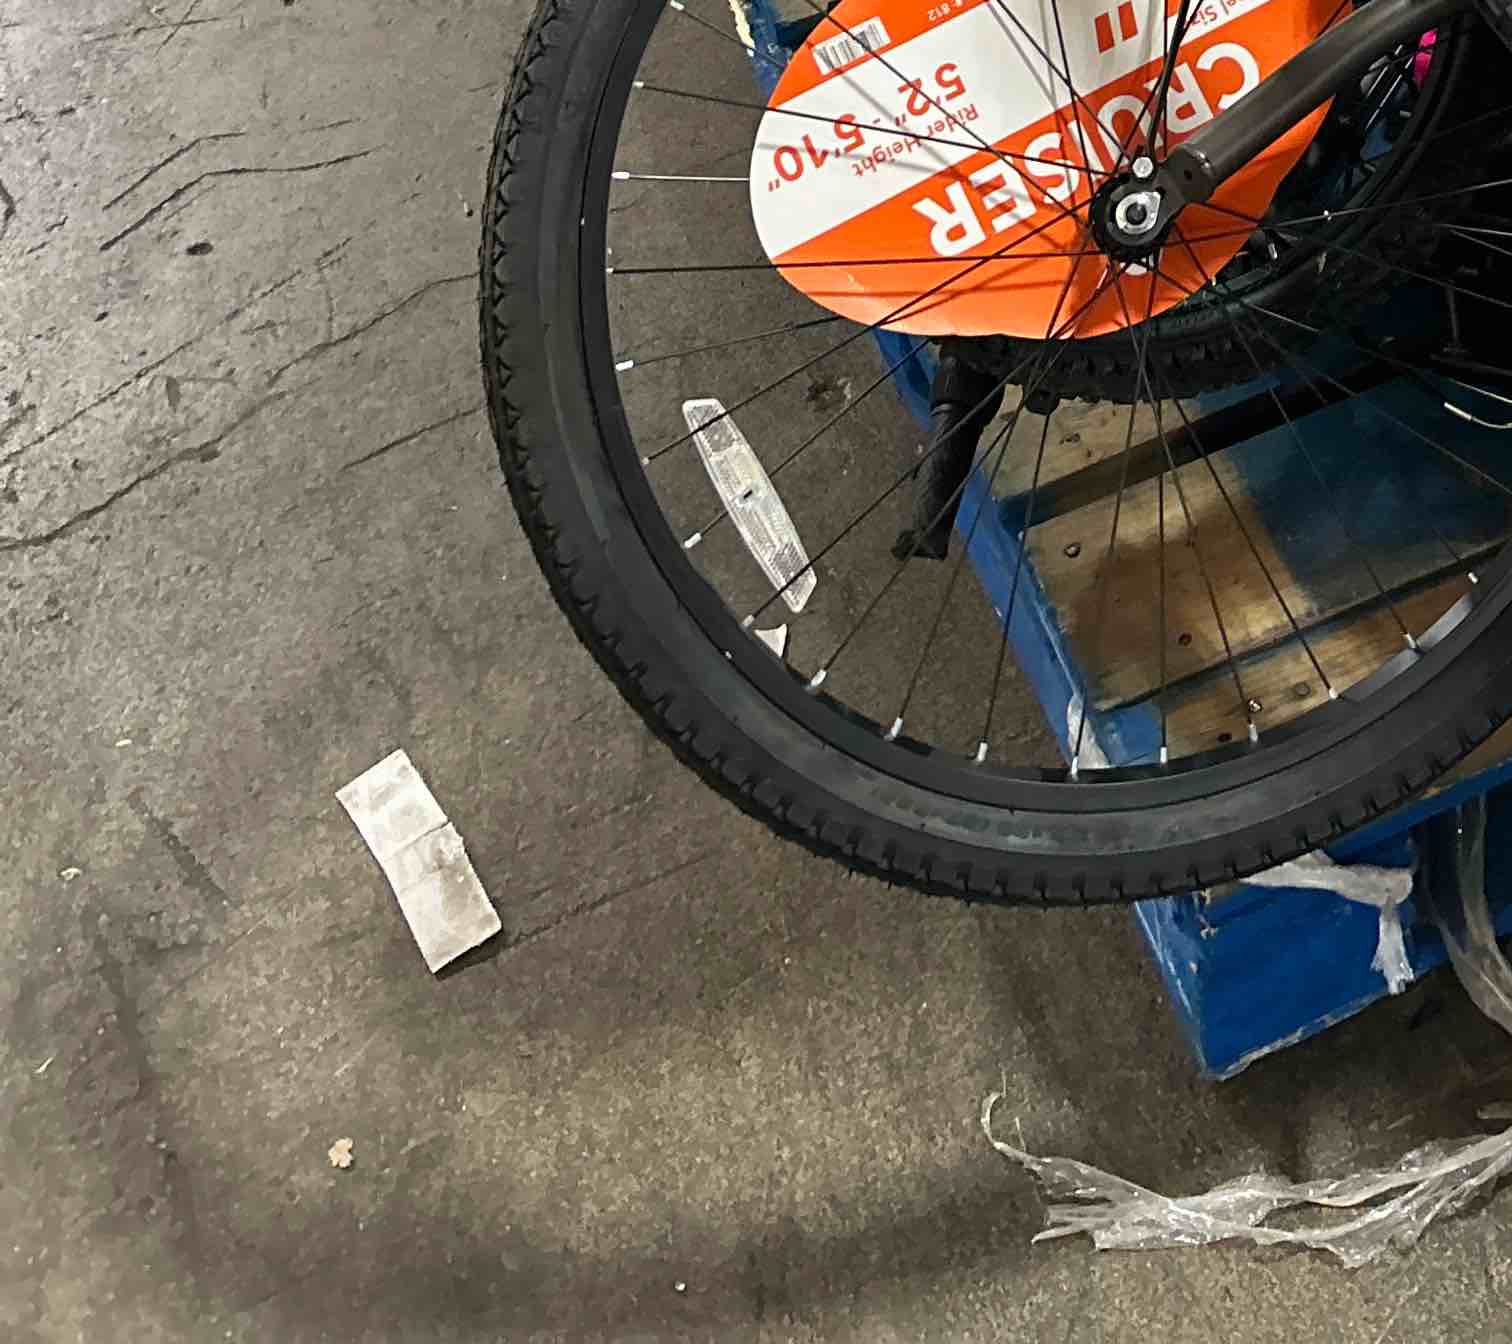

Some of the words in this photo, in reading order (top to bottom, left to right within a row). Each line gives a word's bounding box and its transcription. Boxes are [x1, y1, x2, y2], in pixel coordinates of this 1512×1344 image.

[928, 2, 950, 21] 812
[1187, 5, 1218, 27] Siz
[927, 103, 979, 138] Rider
[768, 113, 866, 193] 5'10"
[852, 133, 922, 177] Height
[911, 42, 1260, 258] CRUISER
